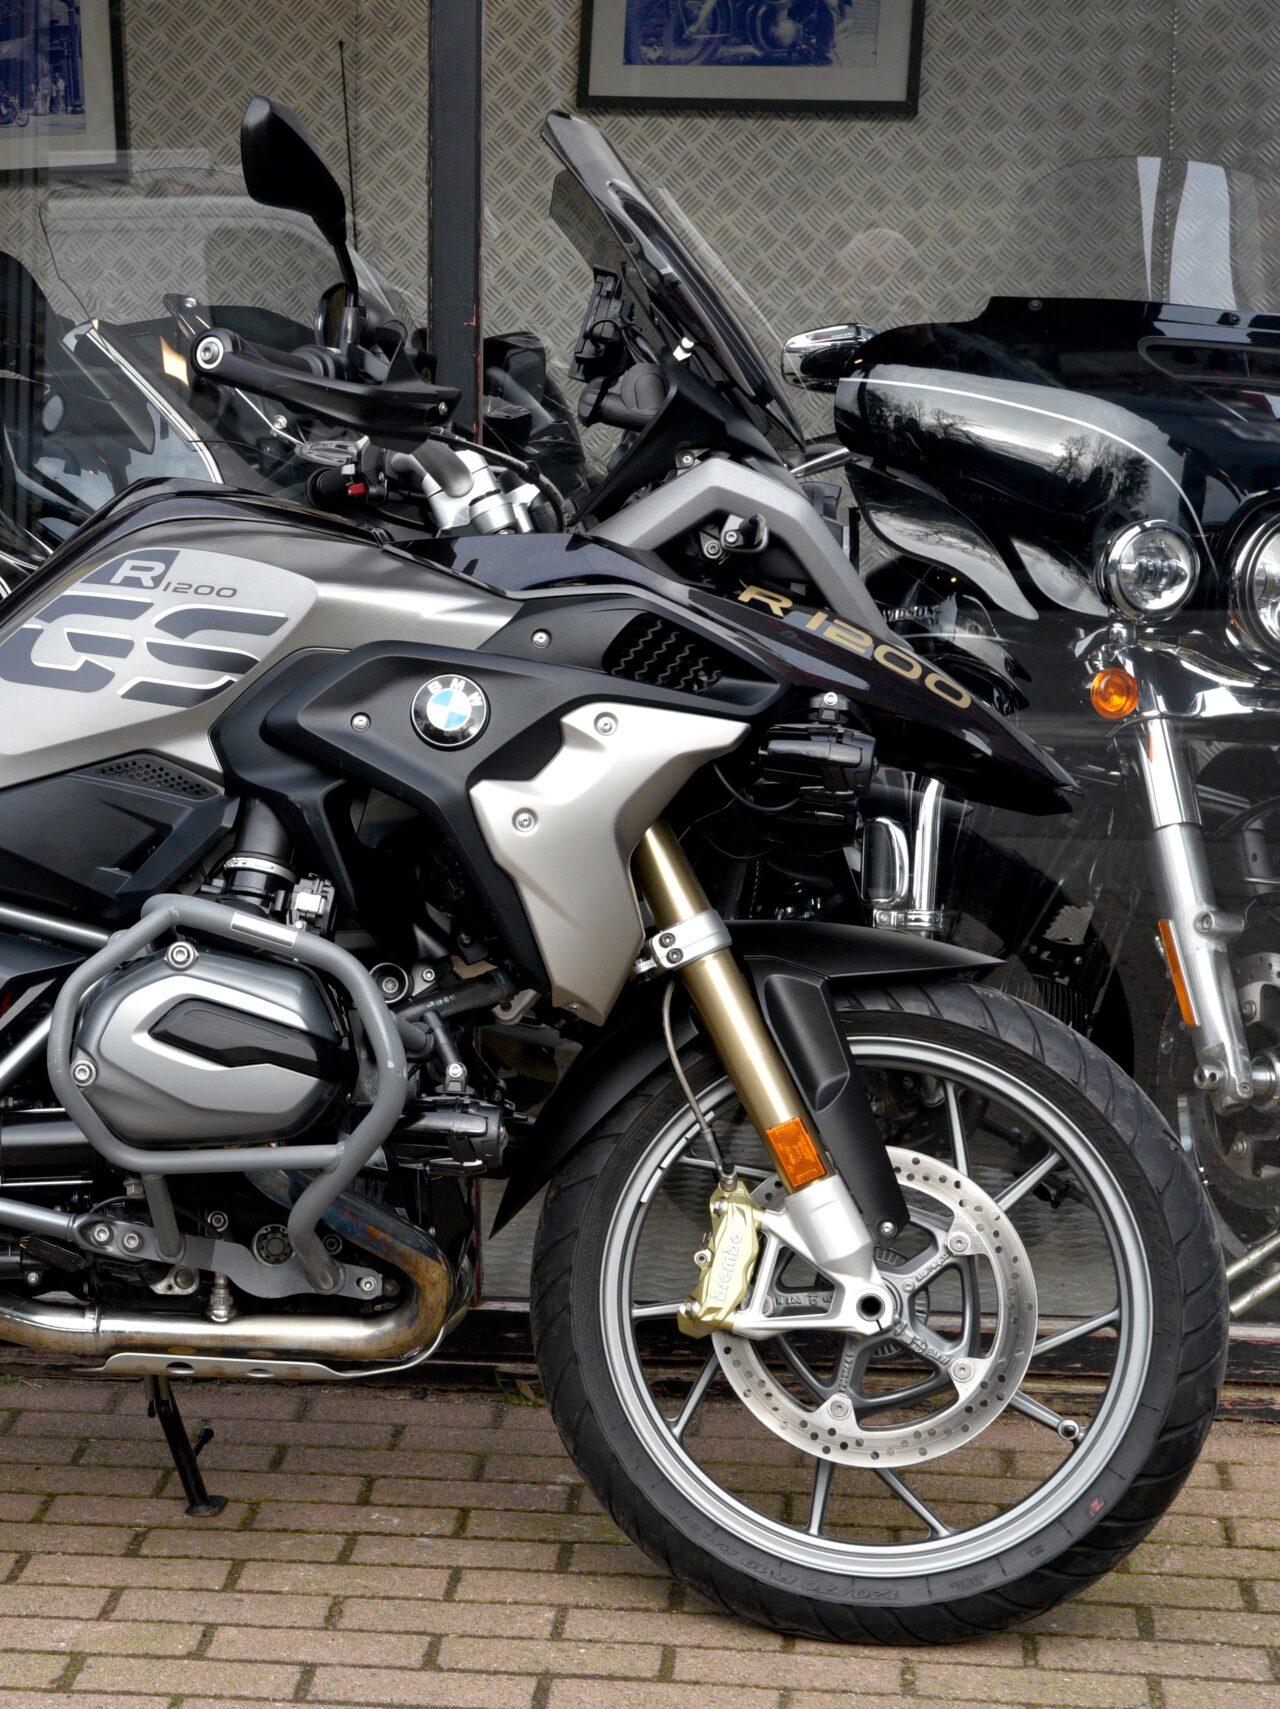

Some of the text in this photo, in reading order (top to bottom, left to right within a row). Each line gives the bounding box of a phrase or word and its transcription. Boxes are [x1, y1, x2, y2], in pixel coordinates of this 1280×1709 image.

[110, 560, 238, 598] R 1200
[882, 603, 937, 622] VIDSON
[737, 585, 971, 708] R 1200
[427, 678, 483, 707] BMW
[710, 1231, 742, 1302] brembo
